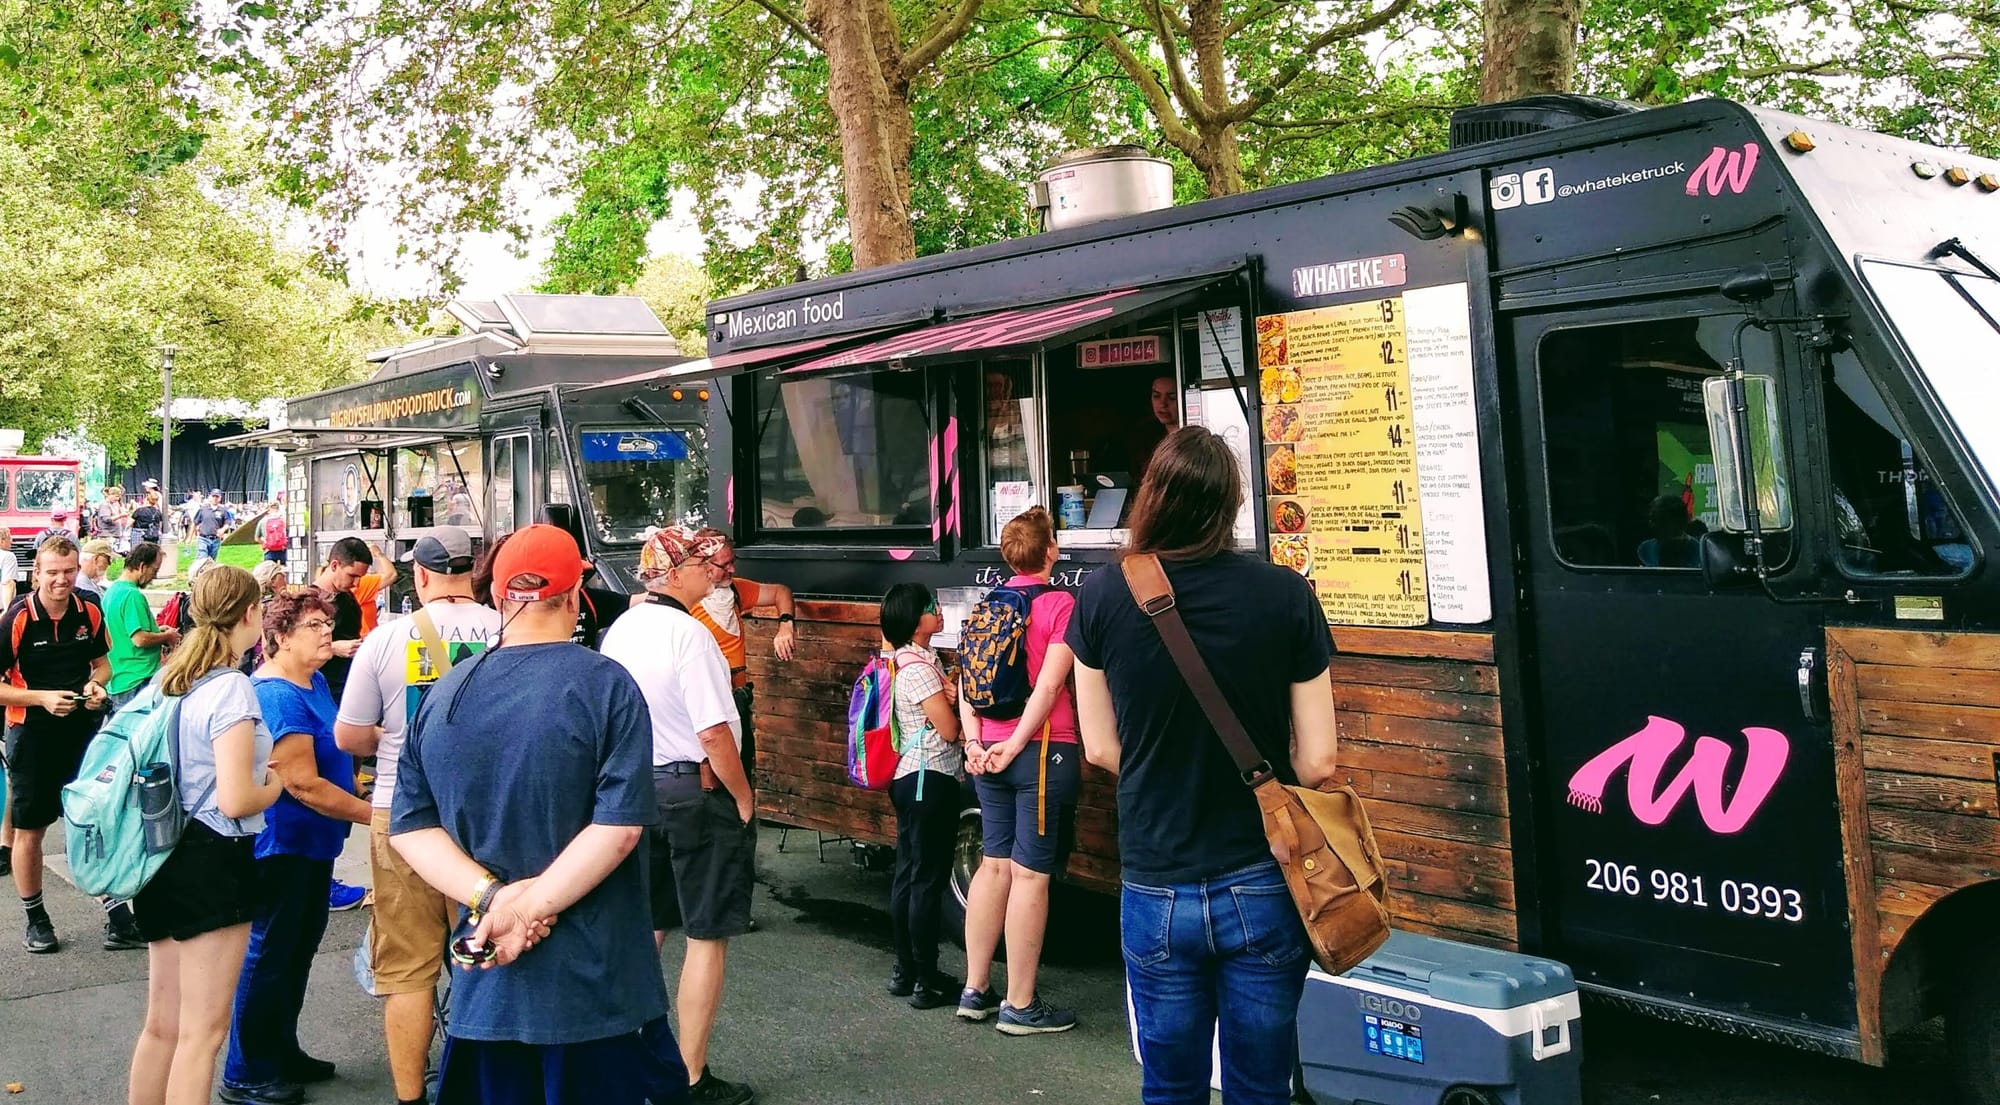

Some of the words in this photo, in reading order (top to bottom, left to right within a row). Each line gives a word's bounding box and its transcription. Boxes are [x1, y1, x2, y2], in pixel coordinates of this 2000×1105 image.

[1557, 161, 1686, 197] @whateketruck
[1297, 258, 1384, 294] WHATEKE
[728, 306, 797, 338] Mexican
[802, 292, 844, 325] food
[1113, 343, 1153, 358] 1044
[1566, 715, 1789, 833] W
[1585, 858, 1640, 896] 206
[1650, 868, 1708, 907] 981
[1720, 879, 1803, 922] 0393
[1358, 992, 1421, 1021] IGLOO
